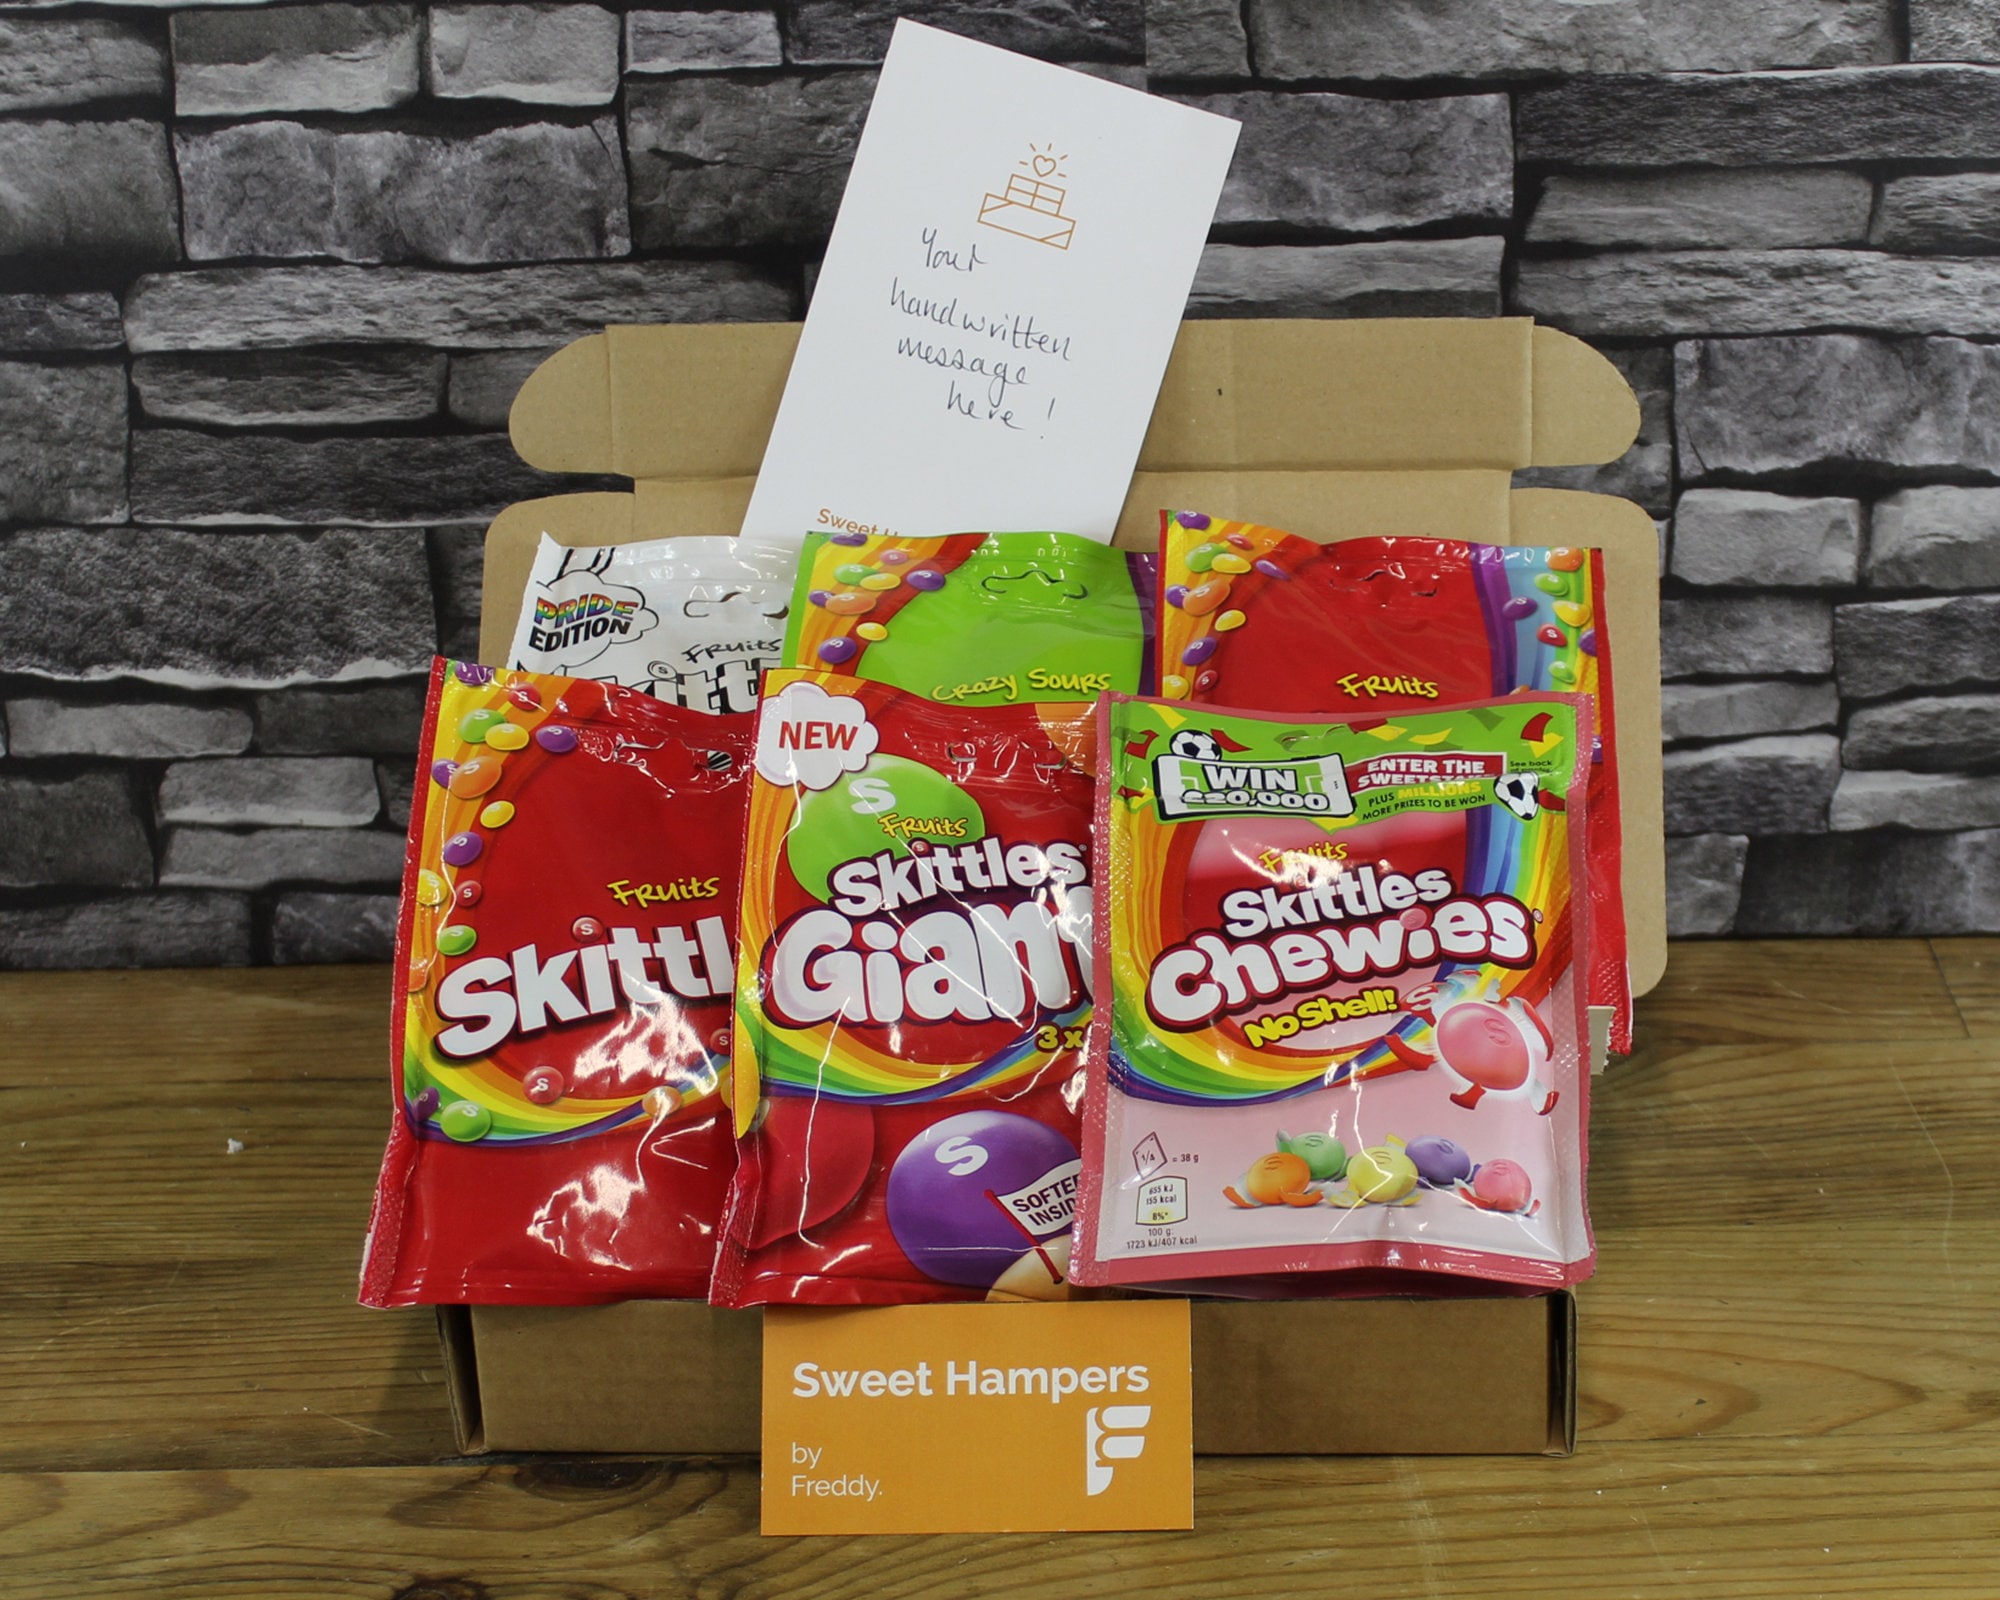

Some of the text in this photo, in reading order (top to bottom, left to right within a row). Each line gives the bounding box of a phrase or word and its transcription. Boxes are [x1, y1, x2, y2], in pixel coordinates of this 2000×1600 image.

[891, 277, 1070, 361] handwritten
[898, 337, 1029, 408] message
[533, 593, 639, 628] PRIDE
[528, 619, 631, 652] EDITION
[682, 638, 782, 663] Fruits
[932, 668, 1111, 700] Crazy Sours
[1336, 674, 1438, 698] Fruits
[779, 721, 859, 750] NEW
[1203, 764, 1298, 792] WIN
[1367, 758, 1485, 774] ENTER THE
[1362, 794, 1486, 820] MORE PRIZES TO BE WON
[1369, 781, 1482, 808] PLUS MILLIONS
[878, 814, 968, 837] Fruits
[1259, 842, 1348, 873] Fuits
[833, 837, 1087, 917] Skittles
[607, 876, 720, 907] Fruits
[1222, 866, 1452, 938] Skittles
[1181, 1153, 1191, 1162] 38
[1193, 1154, 1199, 1163] g
[1160, 1194, 1177, 1203] kcal
[1164, 1184, 1174, 1193] kJ
[1127, 1240, 1145, 1249] 1723
[1180, 1235, 1198, 1245] kcal
[1148, 1227, 1163, 1236] 100
[792, 1360, 1150, 1404] Sweet Hampers
[791, 1442, 822, 1468] by
[791, 1475, 883, 1502] Freddy.
